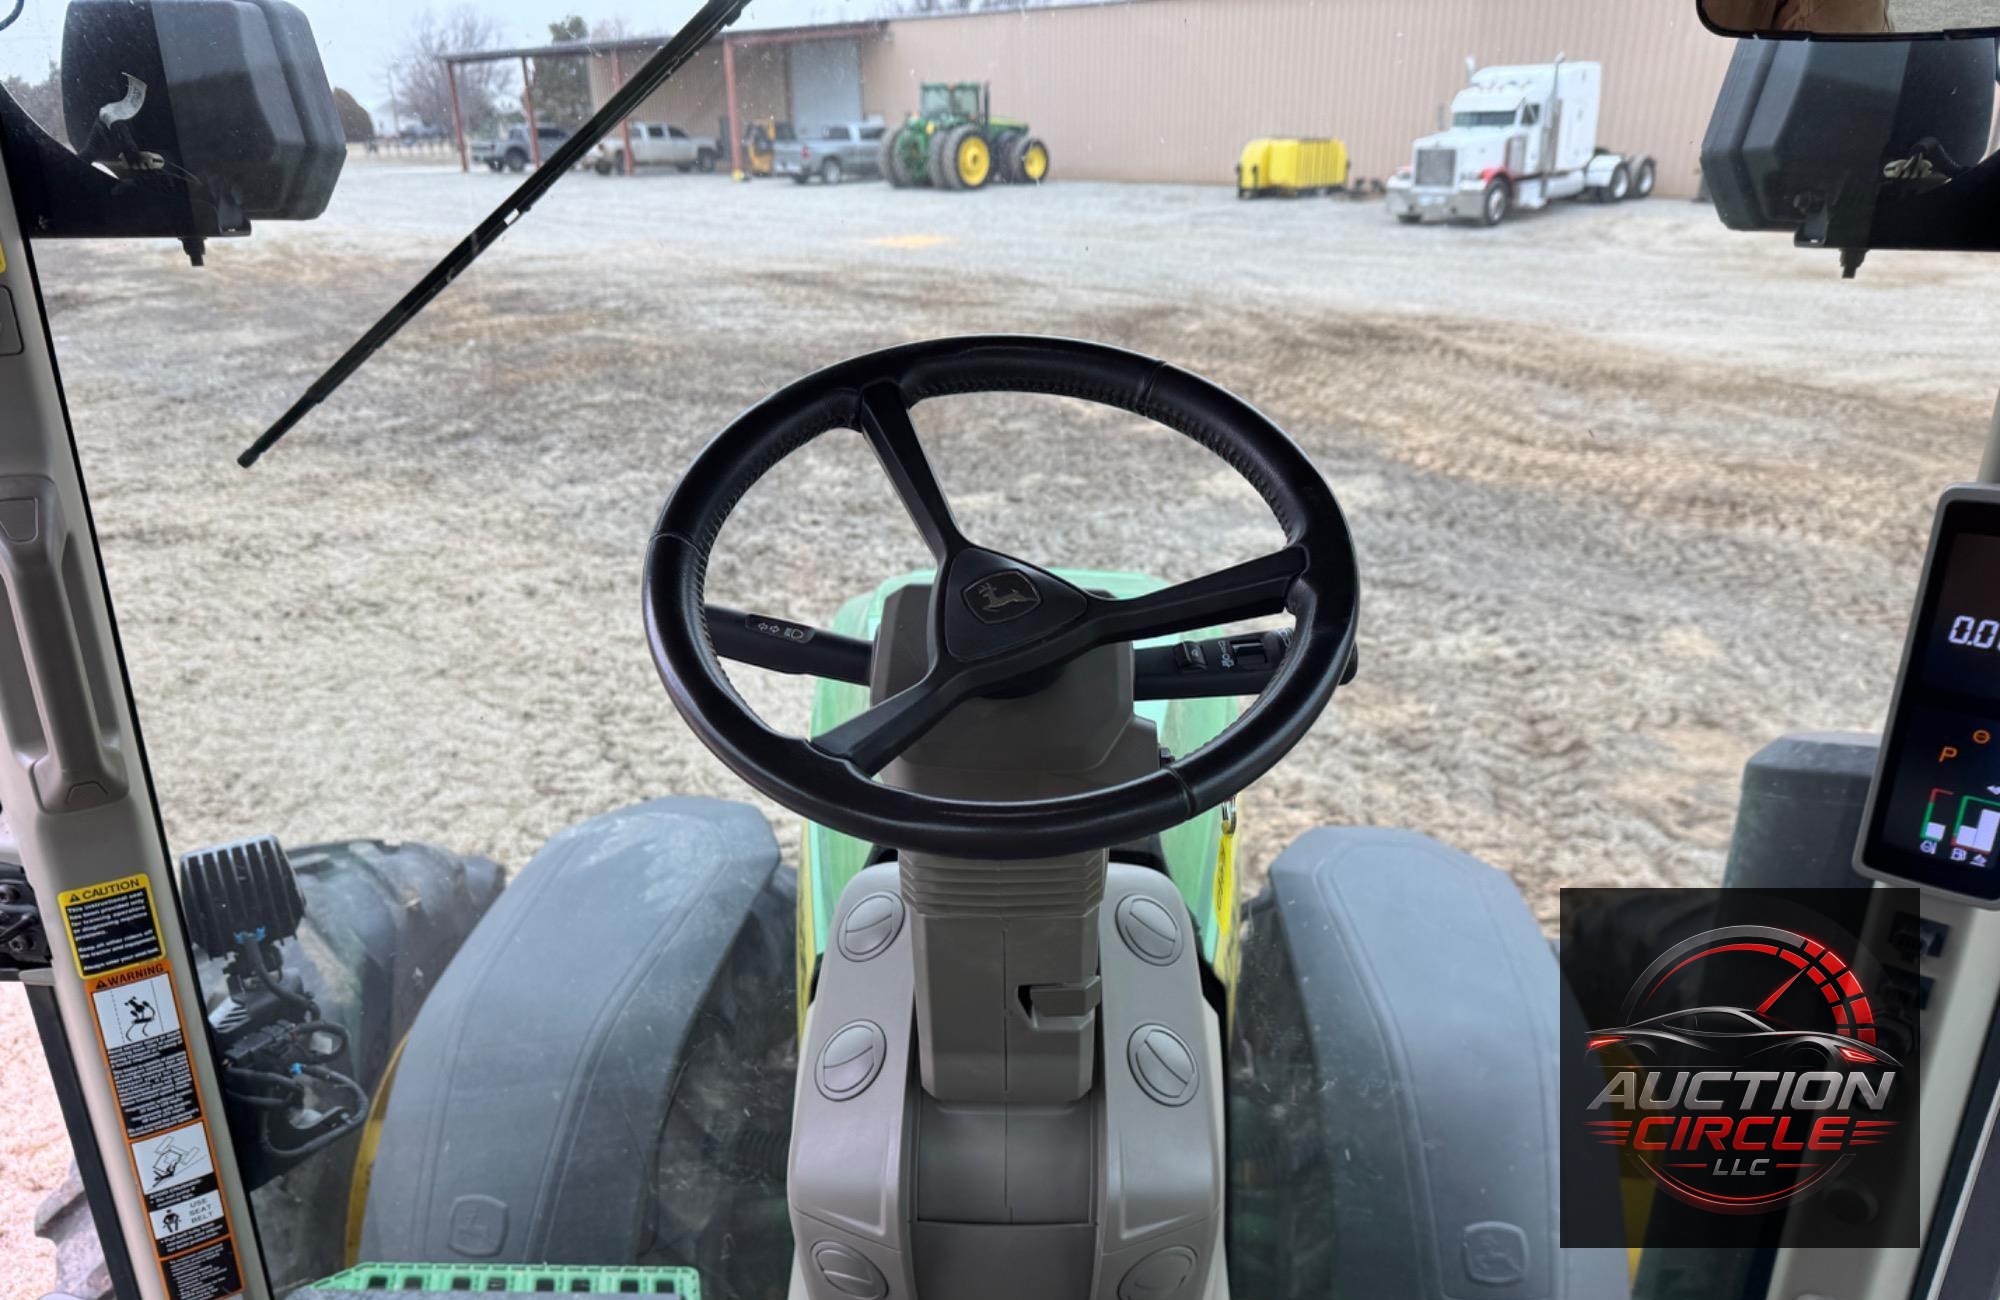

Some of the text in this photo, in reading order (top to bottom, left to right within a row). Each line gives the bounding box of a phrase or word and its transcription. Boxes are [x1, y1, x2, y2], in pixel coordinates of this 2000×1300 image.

[1948, 615, 2000, 651] 0.0
[1938, 746, 1958, 763] P
[82, 878, 140, 900] CAUTION
[108, 963, 164, 986] WARNING
[189, 1203, 212, 1216] SEAT
[190, 1198, 207, 1208] USE
[191, 1211, 213, 1223] BELT
